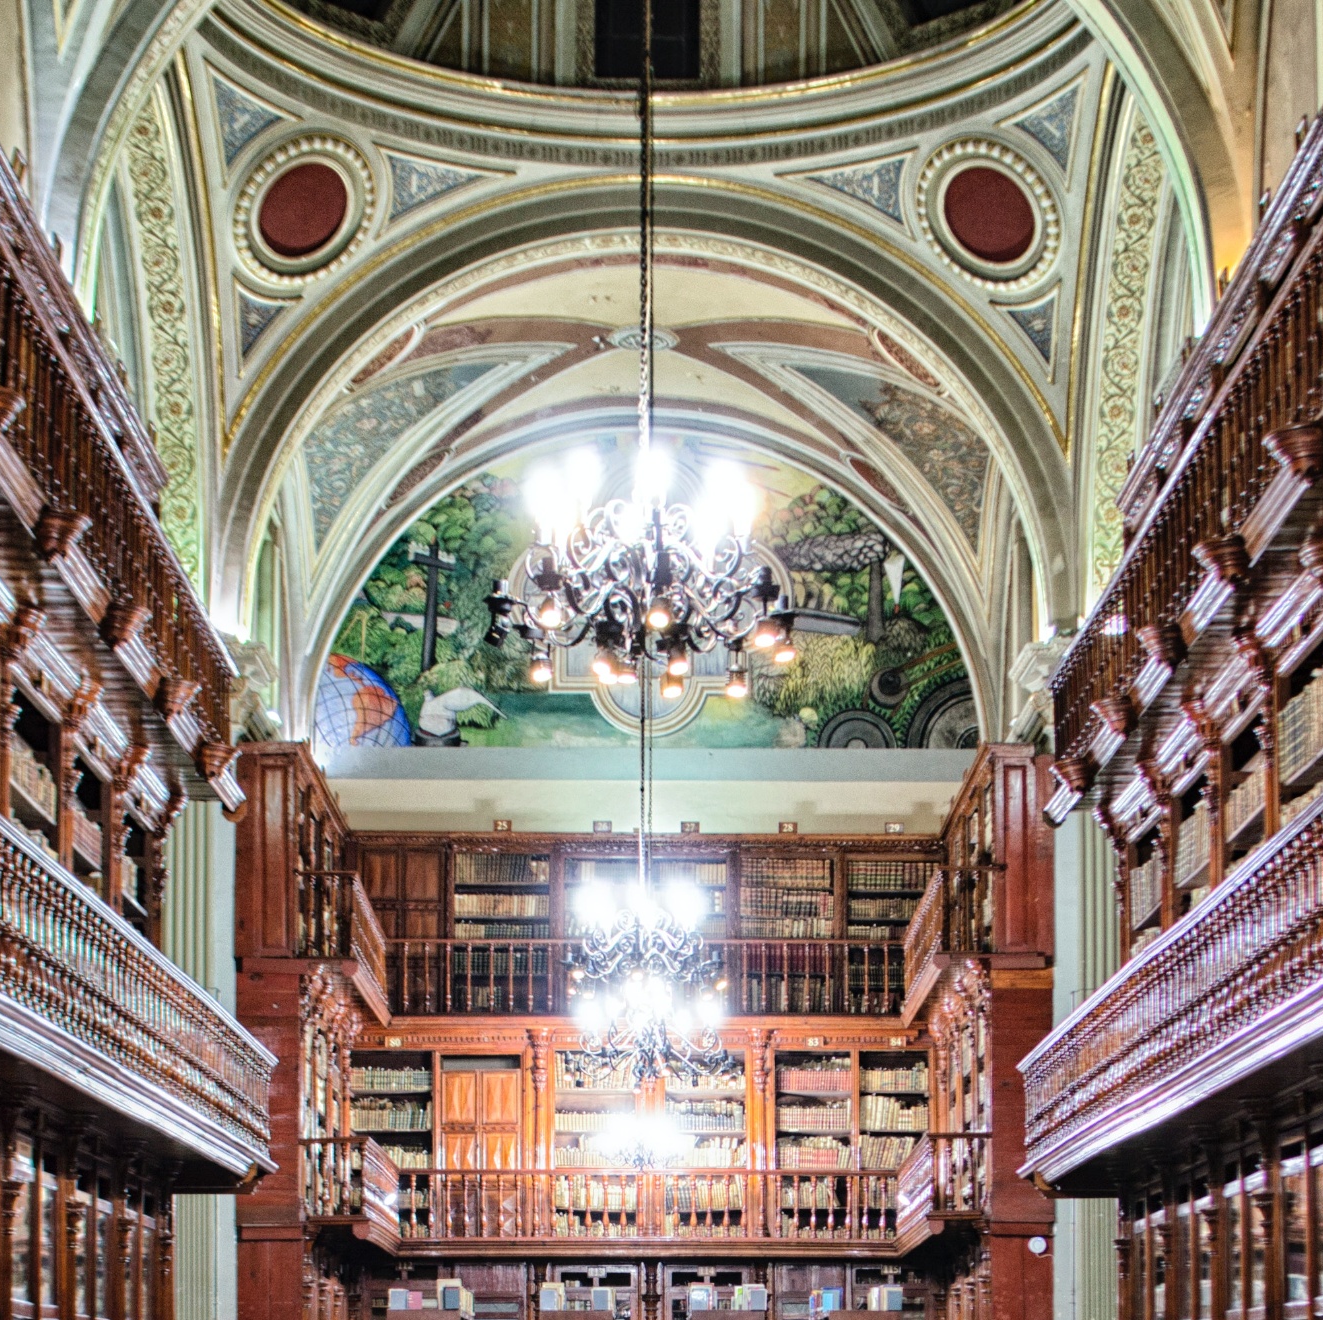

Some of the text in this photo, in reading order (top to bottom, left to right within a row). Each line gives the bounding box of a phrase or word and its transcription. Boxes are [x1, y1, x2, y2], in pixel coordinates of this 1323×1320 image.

[496, 821, 508, 831] 25
[598, 822, 608, 831] 26
[685, 822, 695, 832] 27
[782, 823, 794, 833] 28
[888, 823, 900, 833] 29
[807, 1037, 819, 1047] 83
[890, 1037, 901, 1047] 84
[883, 1265, 898, 1275] 115
